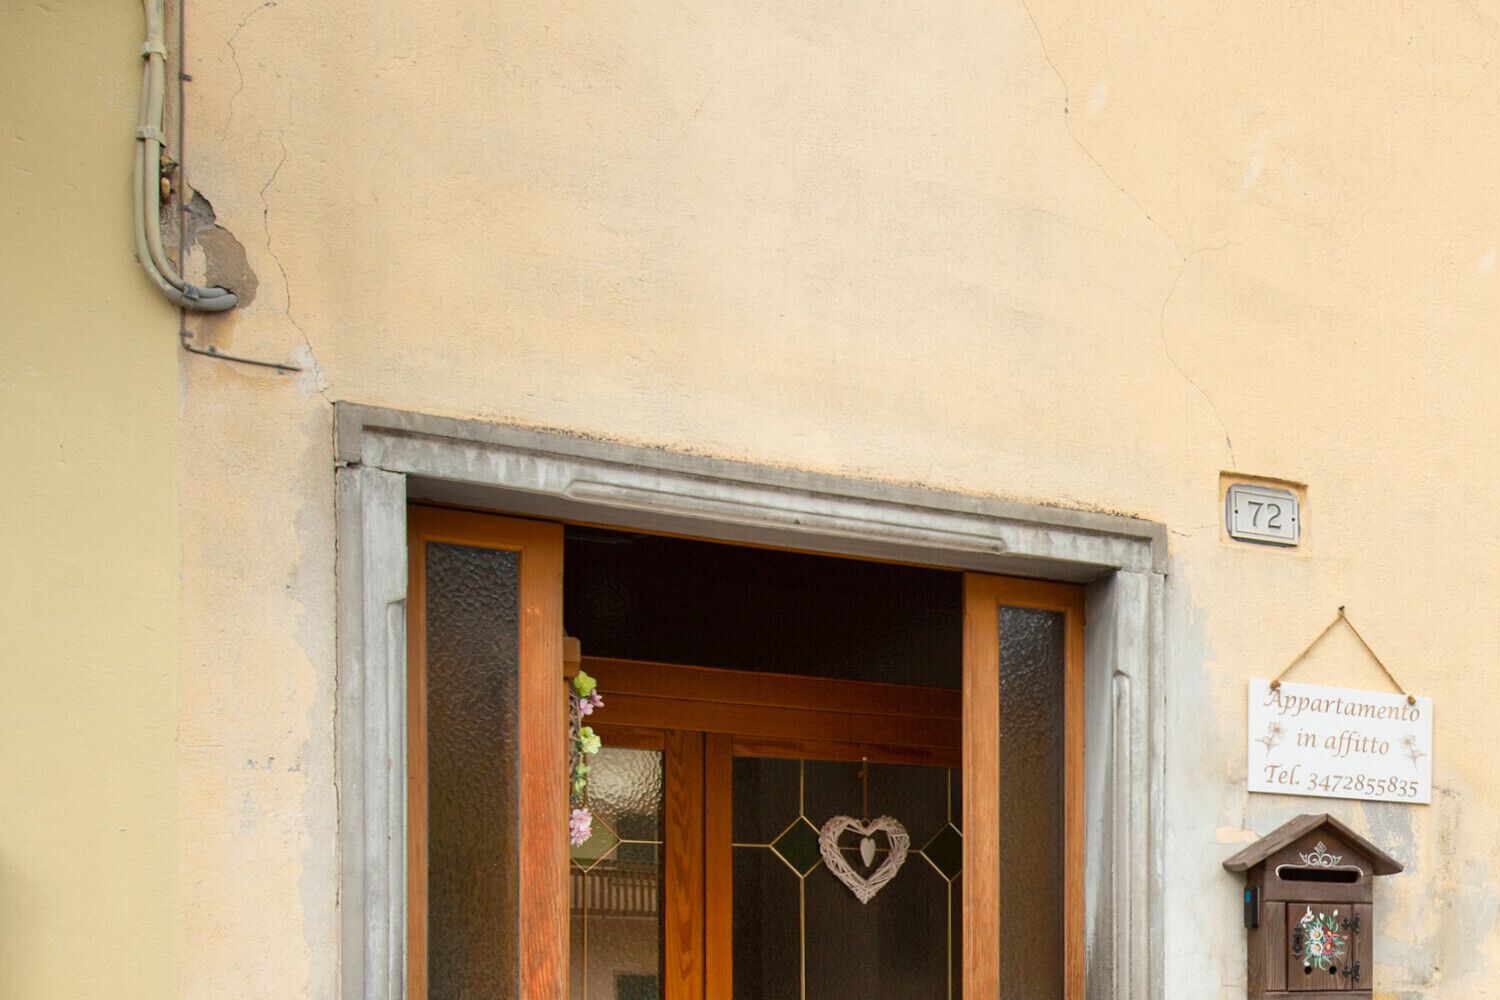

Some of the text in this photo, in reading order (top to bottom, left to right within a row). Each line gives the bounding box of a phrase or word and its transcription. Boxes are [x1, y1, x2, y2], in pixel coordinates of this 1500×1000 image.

[1247, 500, 1282, 530] 72
[1263, 689, 1421, 722] Appartamento
[1296, 728, 1390, 758] in affitto
[1263, 763, 1419, 798] Tel. 3472855835
